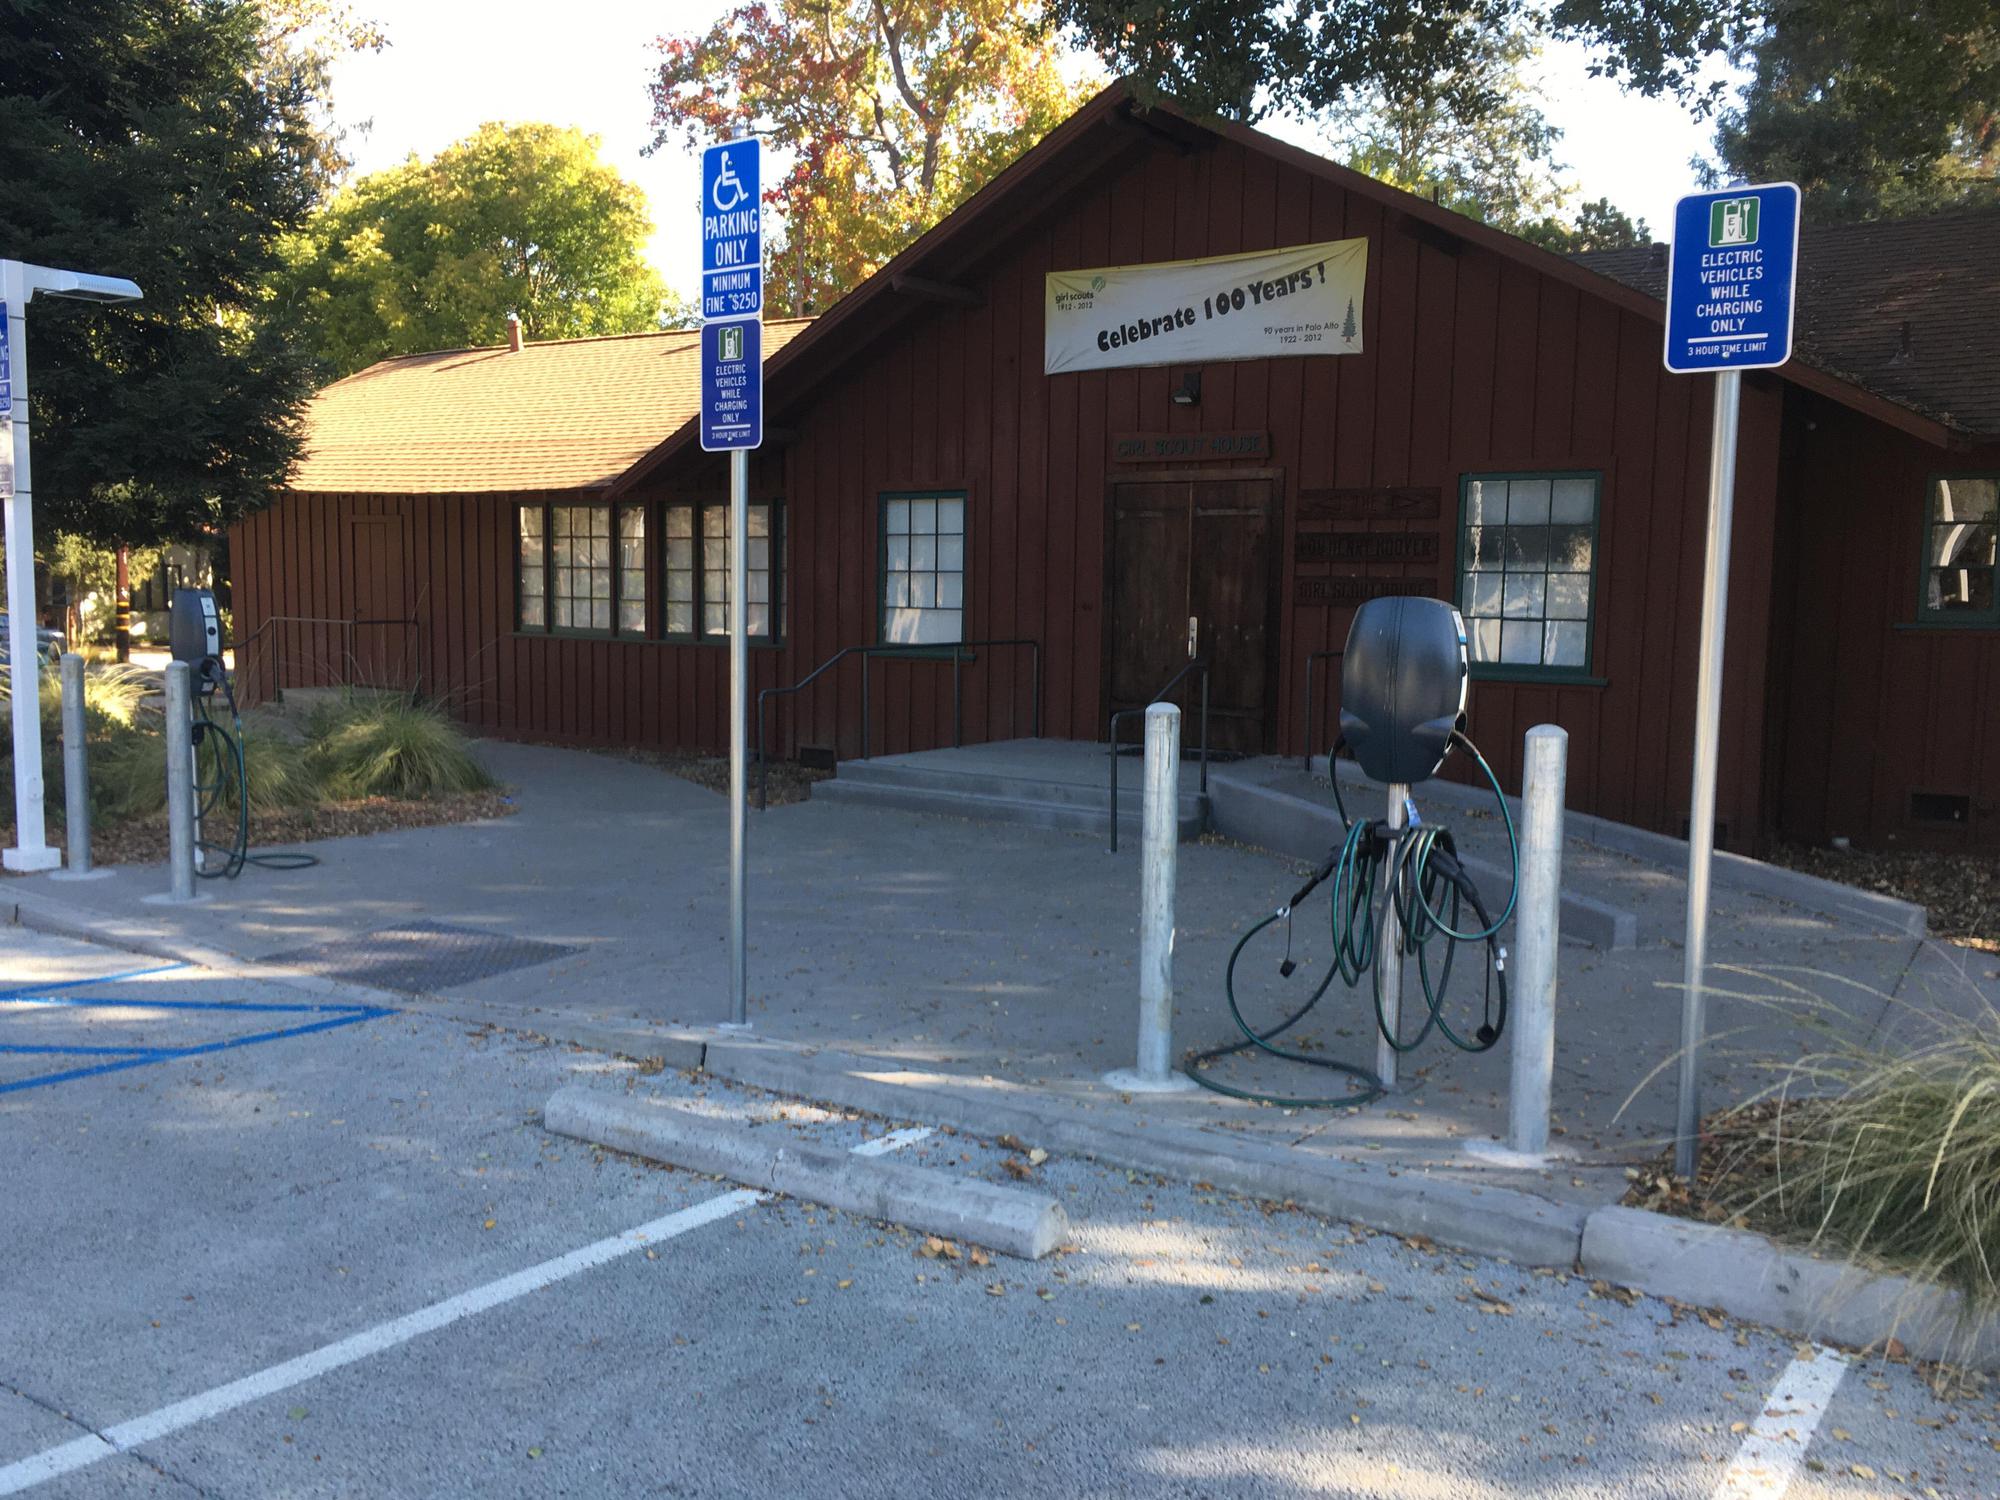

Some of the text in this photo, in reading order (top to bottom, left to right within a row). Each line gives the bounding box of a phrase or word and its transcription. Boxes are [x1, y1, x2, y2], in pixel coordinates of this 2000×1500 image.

[705, 209, 758, 240] PARKING
[715, 238, 748, 266] ONLY
[1702, 249, 1763, 268] ELECTRIC
[712, 272, 751, 292] MINIMUM
[1701, 266, 1763, 284] VEHICLES
[1055, 291, 1094, 304] girl scouts
[1711, 284, 1750, 300] WHILE
[706, 291, 758, 313] FINE $250
[1057, 303, 1072, 311] 1912
[1078, 301, 1093, 310] 2012
[1696, 300, 1763, 317] CHARGING
[1097, 306, 1196, 352] Celebrate
[1203, 287, 1246, 320] 100
[1711, 318, 1746, 333] ONLY
[1264, 321, 1340, 336] 90 years in Palo Alto
[1280, 335, 1297, 344] 1922
[1304, 333, 1322, 343] 2012
[1688, 341, 1767, 356] 3 HOUR TIME LIMIT
[715, 364, 746, 376] ELECTRIC
[715, 376, 747, 388] VEHICLES
[720, 388, 741, 399] WHILE
[714, 400, 748, 412] CHARGING
[722, 412, 740, 423] ONLY
